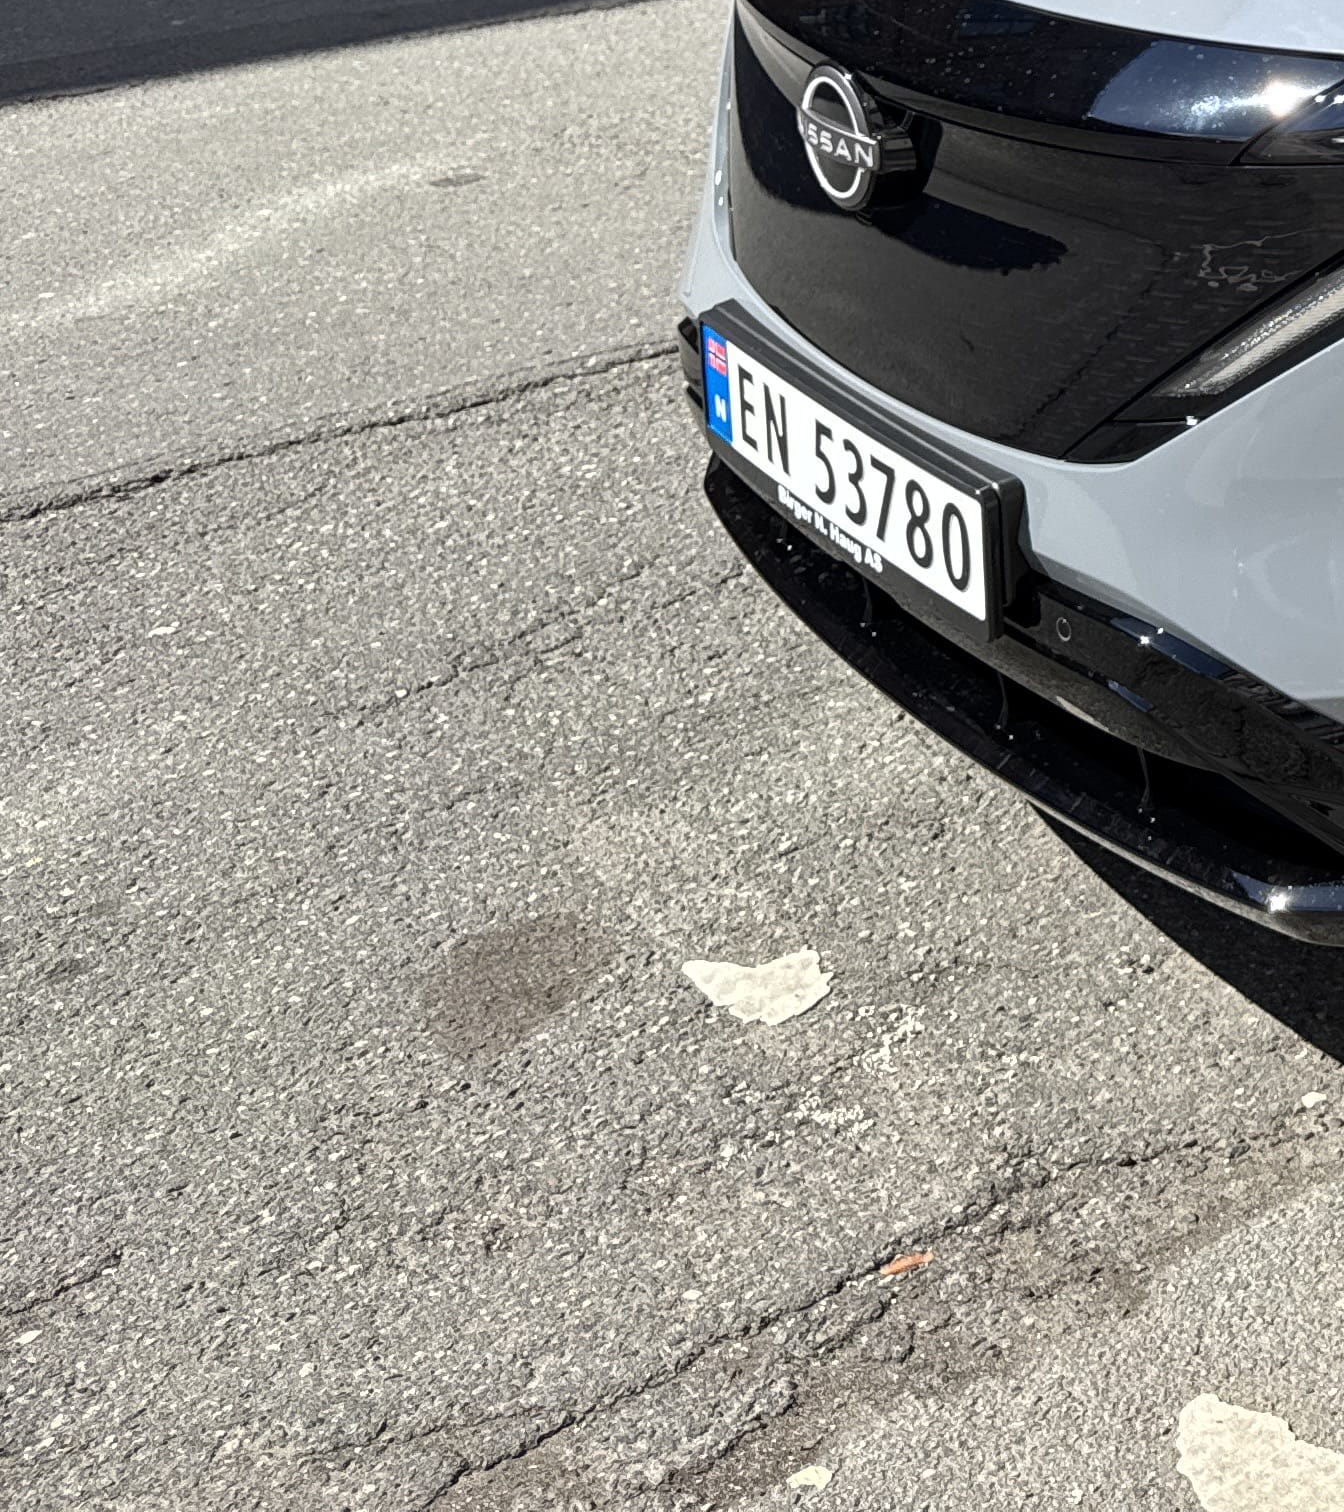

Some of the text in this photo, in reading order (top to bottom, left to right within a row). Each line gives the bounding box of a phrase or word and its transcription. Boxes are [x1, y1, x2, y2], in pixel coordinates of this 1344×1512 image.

[807, 122, 875, 168] SSAN
[714, 393, 728, 423] N
[737, 363, 971, 594] EN 53780
[777, 484, 813, 524] Birger
[829, 521, 862, 563] Haug
[864, 546, 883, 573] AS
